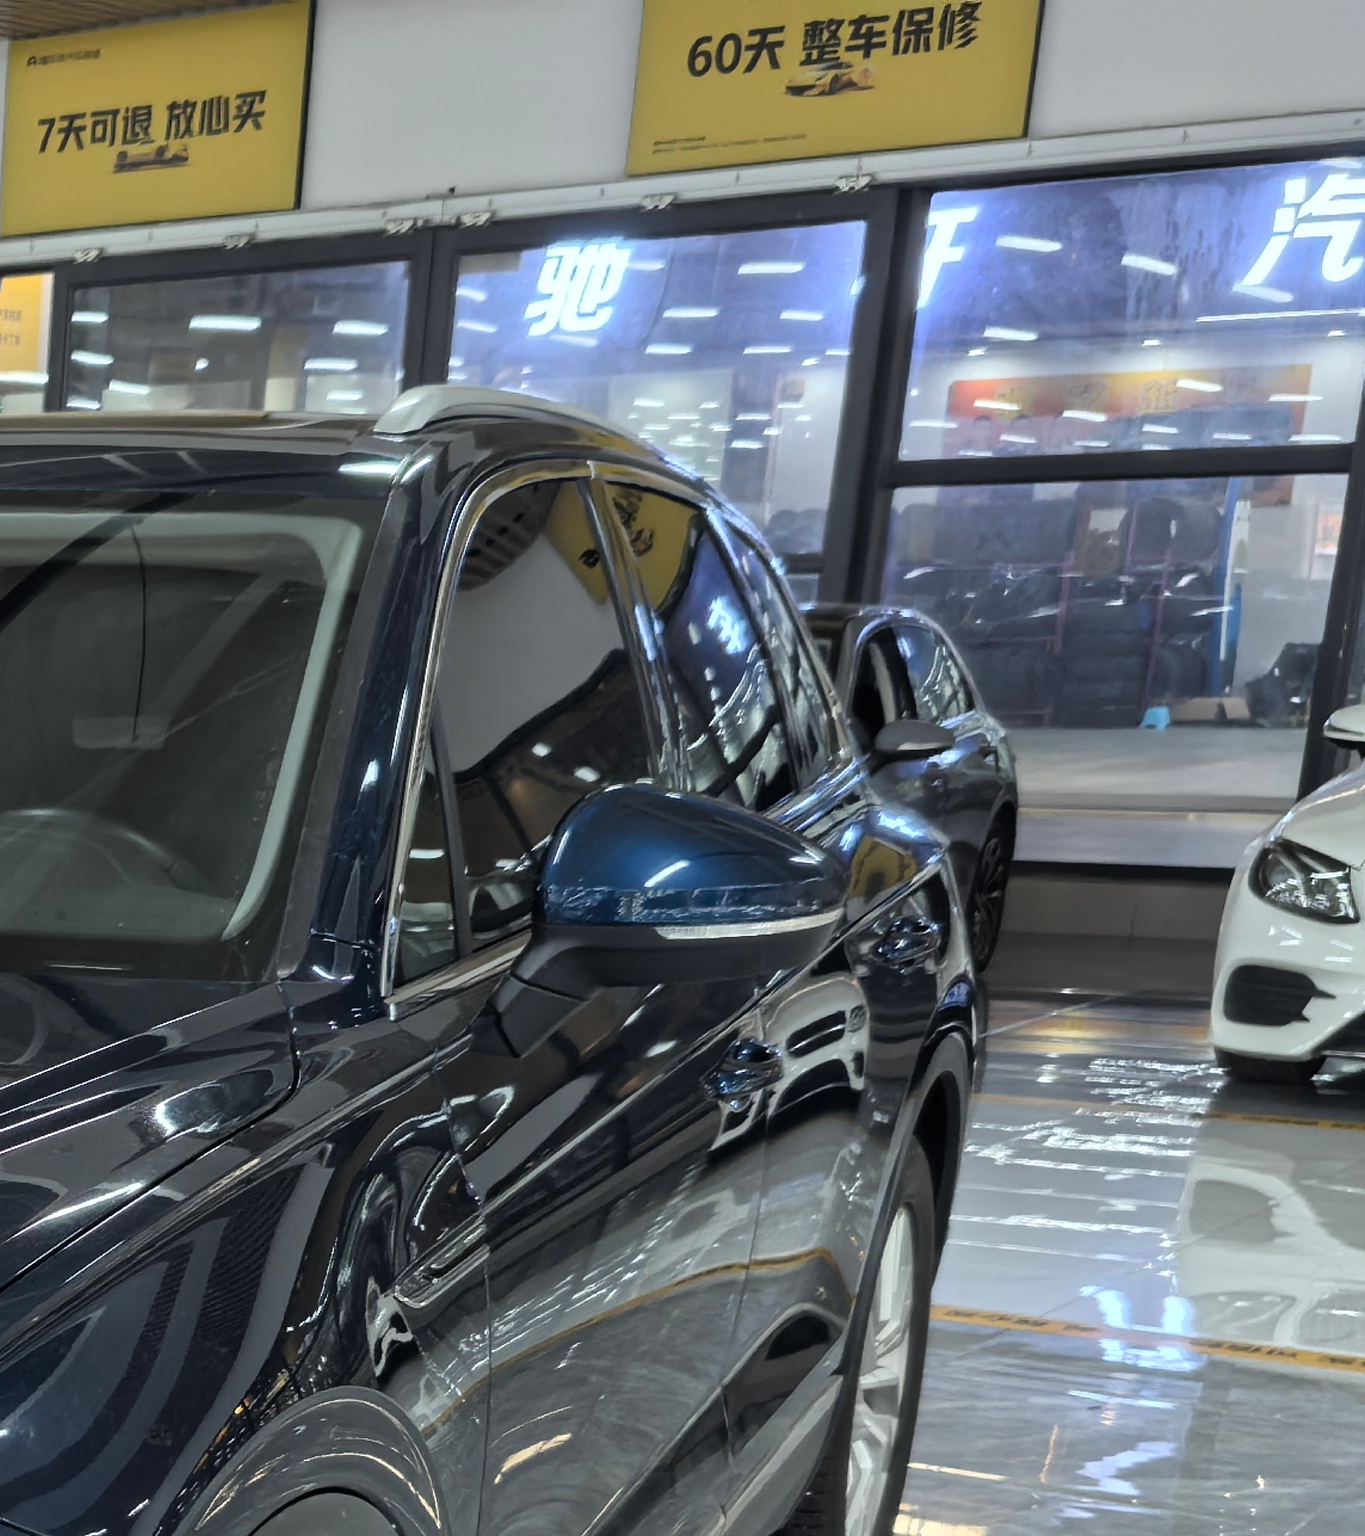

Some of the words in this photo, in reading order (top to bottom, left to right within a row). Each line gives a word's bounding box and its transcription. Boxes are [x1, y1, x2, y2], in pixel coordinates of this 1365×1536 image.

[687, 25, 786, 78] 60天
[799, 1, 983, 67] 整车保修
[37, 104, 155, 154] 7天可退
[164, 89, 267, 142] 放心买
